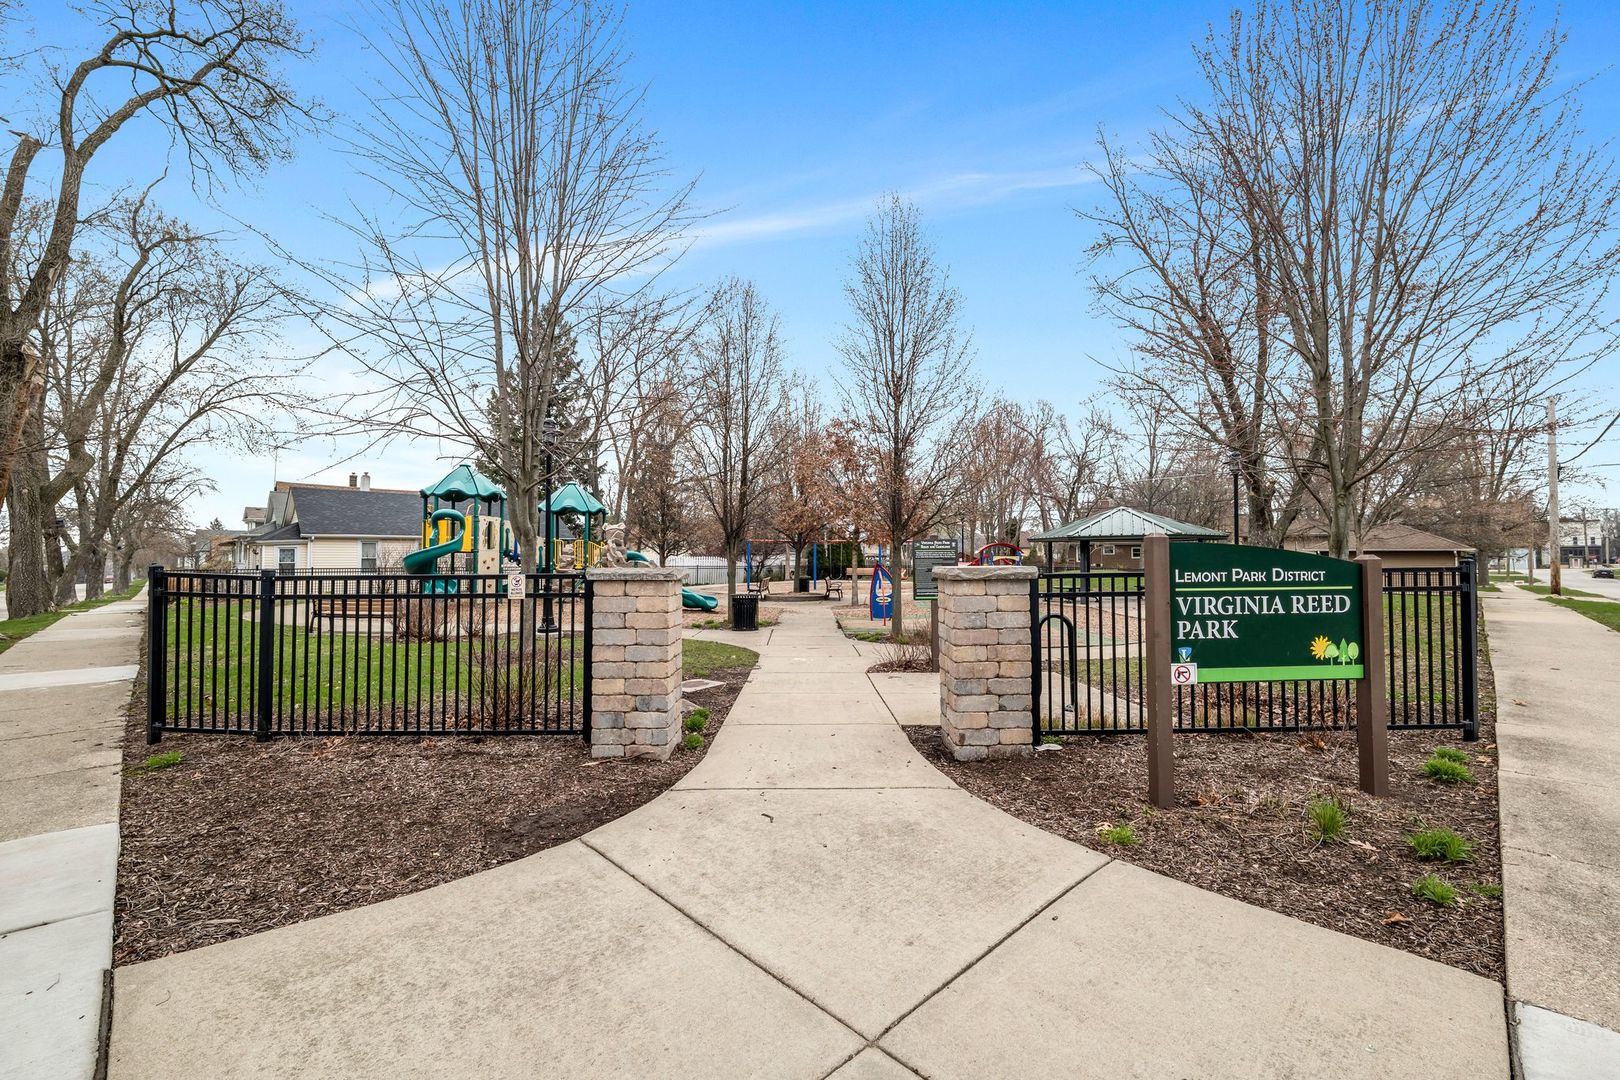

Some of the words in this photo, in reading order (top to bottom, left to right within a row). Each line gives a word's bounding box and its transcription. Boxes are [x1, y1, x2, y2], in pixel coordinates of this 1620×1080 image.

[1175, 569, 1228, 583] LEMONT
[1231, 568, 1267, 582] PARK
[1272, 567, 1326, 582] DISTRICT
[1175, 595, 1286, 616] VIRGINIA
[1290, 594, 1351, 614] REED
[1176, 619, 1239, 640] PARK
